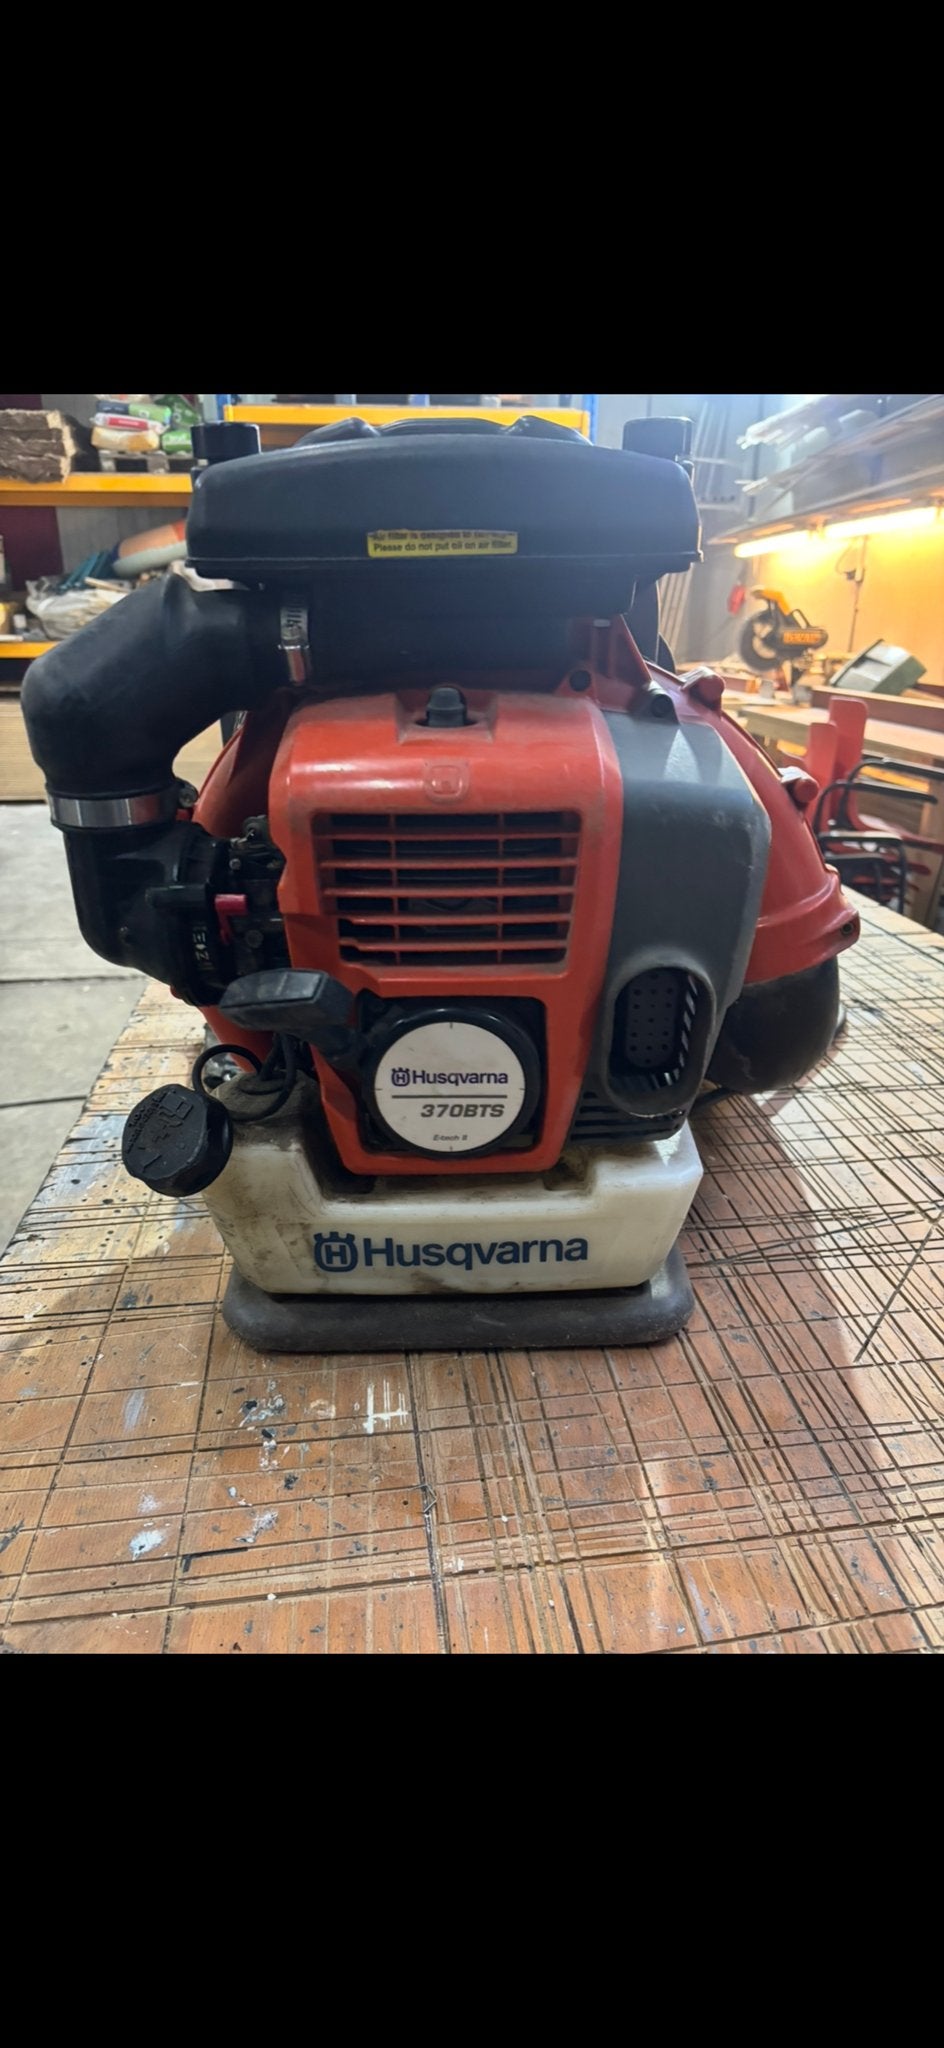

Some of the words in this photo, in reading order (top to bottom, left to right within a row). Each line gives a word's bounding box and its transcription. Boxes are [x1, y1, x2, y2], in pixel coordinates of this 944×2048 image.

[374, 543, 403, 551] Please
[405, 542, 416, 551] do
[418, 543, 432, 551] not
[435, 542, 449, 552] put
[451, 541, 463, 550] oil
[464, 542, 476, 550] on
[478, 541, 490, 549] air
[412, 1070, 508, 1087] Husqvarna
[421, 1104, 505, 1118] 370BTS
[363, 1237, 589, 1271] Husqvarna
